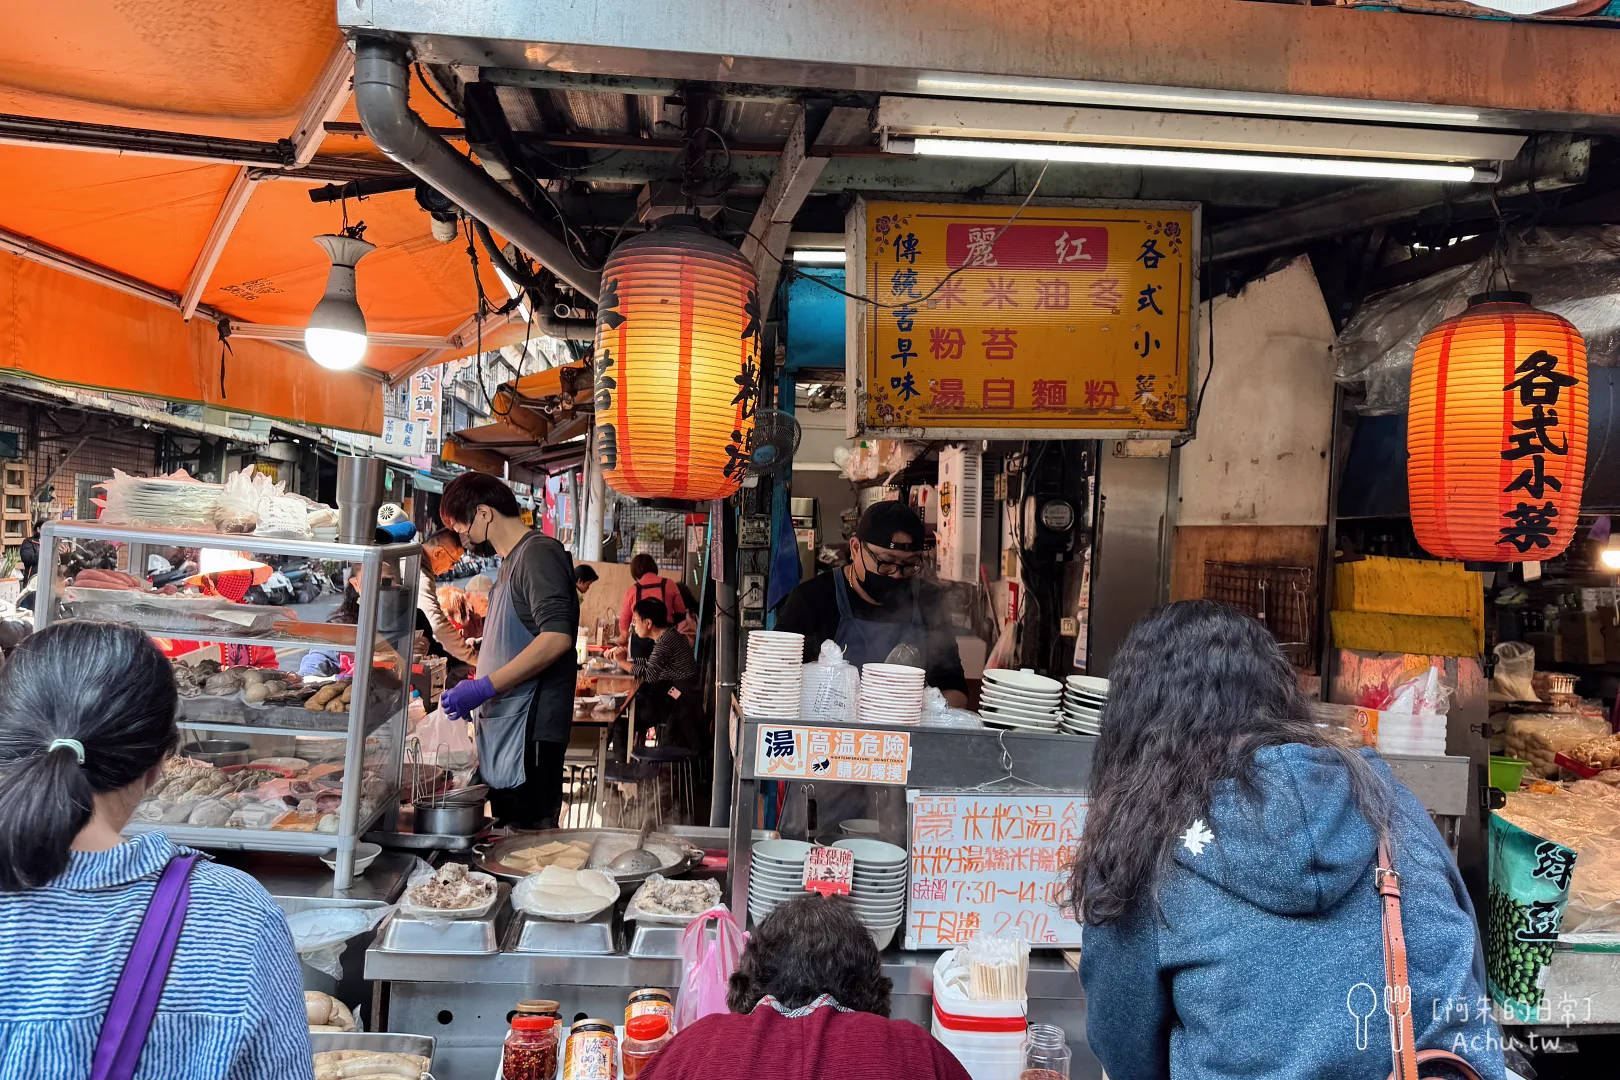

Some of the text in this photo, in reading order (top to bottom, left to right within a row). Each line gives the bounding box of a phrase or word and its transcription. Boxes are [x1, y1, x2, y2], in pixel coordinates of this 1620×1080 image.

[889, 233, 922, 402] 傳統古早味
[1134, 238, 1166, 403] 各式小菜
[1495, 349, 1579, 553] 各式小菜
[837, 761, 903, 781] 請勿觸摸
